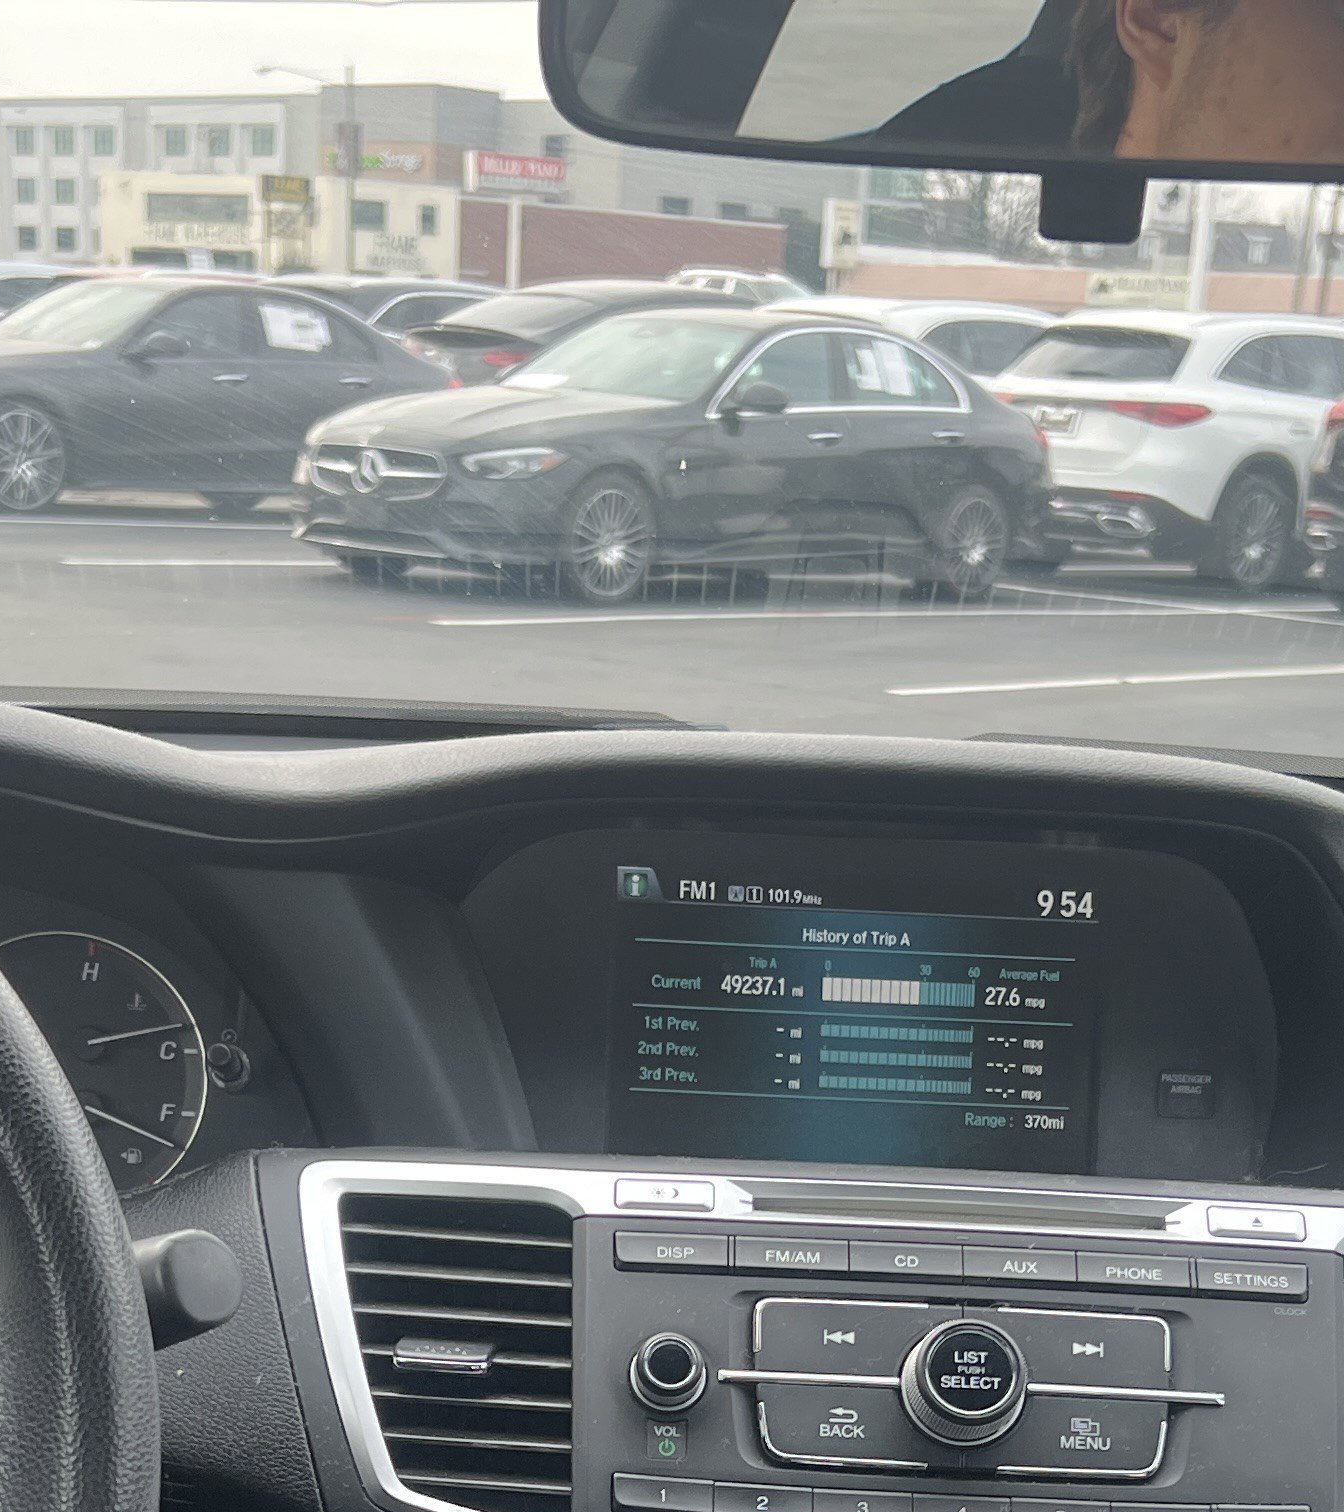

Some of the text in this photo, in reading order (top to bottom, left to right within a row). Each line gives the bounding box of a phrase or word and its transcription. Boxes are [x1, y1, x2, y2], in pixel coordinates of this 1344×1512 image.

[678, 879, 717, 901] FM1
[802, 928, 912, 949] History of Trip A
[749, 956, 779, 970] Trip A
[824, 959, 833, 972] 0
[919, 964, 932, 977] 30
[81, 962, 100, 982] H
[967, 966, 981, 978] 60
[999, 968, 1060, 983] Average Fuel
[650, 973, 1046, 1010] Current 49237.1 mi 27.6 mpg
[644, 1015, 663, 1030] 1st
[667, 1016, 700, 1032] Prev.
[1023, 1038, 1044, 1051] mpg
[159, 1041, 177, 1061] C
[637, 1040, 663, 1056] 2nd
[666, 1042, 699, 1058] Prev.
[1022, 1064, 1043, 1077] mpg
[638, 1065, 662, 1081] 3rd
[665, 1067, 698, 1083] Prev.
[1021, 1090, 1042, 1102] mpg
[1170, 1085, 1202, 1095] AIRBAG
[159, 1103, 177, 1122] F
[964, 1111, 1007, 1129] Range
[656, 1245, 695, 1260] DISP
[765, 1249, 821, 1265] FM/AM
[894, 1254, 920, 1268] CD
[1002, 1260, 1039, 1275] AUX
[1105, 1265, 1163, 1282] PHONE
[1213, 1271, 1290, 1289] SETTINGS
[954, 1350, 989, 1365] LIST
[957, 1366, 986, 1375] PUSH
[940, 1375, 1002, 1391] SELECT
[653, 1425, 681, 1439] VOL
[819, 1424, 866, 1439] BACK
[1059, 1435, 1112, 1451] MENU
[659, 1488, 667, 1503] 1
[756, 1495, 769, 1511] 2
